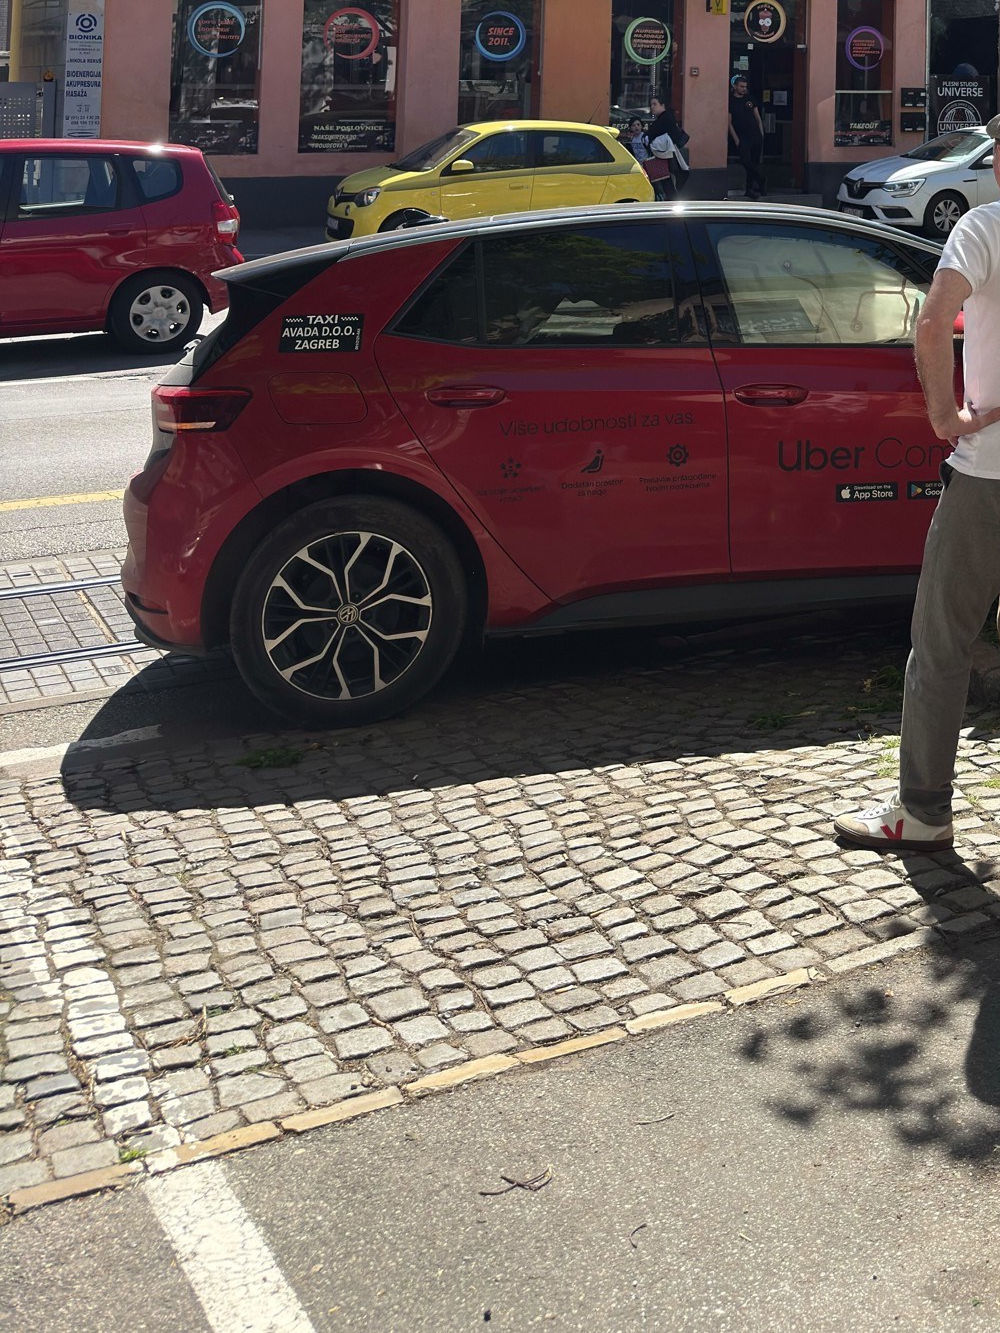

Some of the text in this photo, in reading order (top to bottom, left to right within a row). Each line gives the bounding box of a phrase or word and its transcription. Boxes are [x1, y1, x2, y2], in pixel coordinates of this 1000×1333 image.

[487, 27, 515, 36] SINCE
[488, 37, 510, 46] 2011.
[66, 70, 102, 78] BIOENERGIJA
[66, 80, 101, 88] AKUPRESURA
[65, 88, 88, 97] MASAŽA
[937, 87, 984, 97] UNIVERSE
[306, 314, 339, 325] TAXI
[281, 325, 356, 338] AVADA D.O.O.
[294, 339, 341, 350] ZAGREB
[500, 419, 539, 437] Više
[543, 412, 637, 435] udobnosti
[641, 415, 661, 428] za
[778, 439, 865, 472] Uber
[853, 489, 894, 499] App Store
